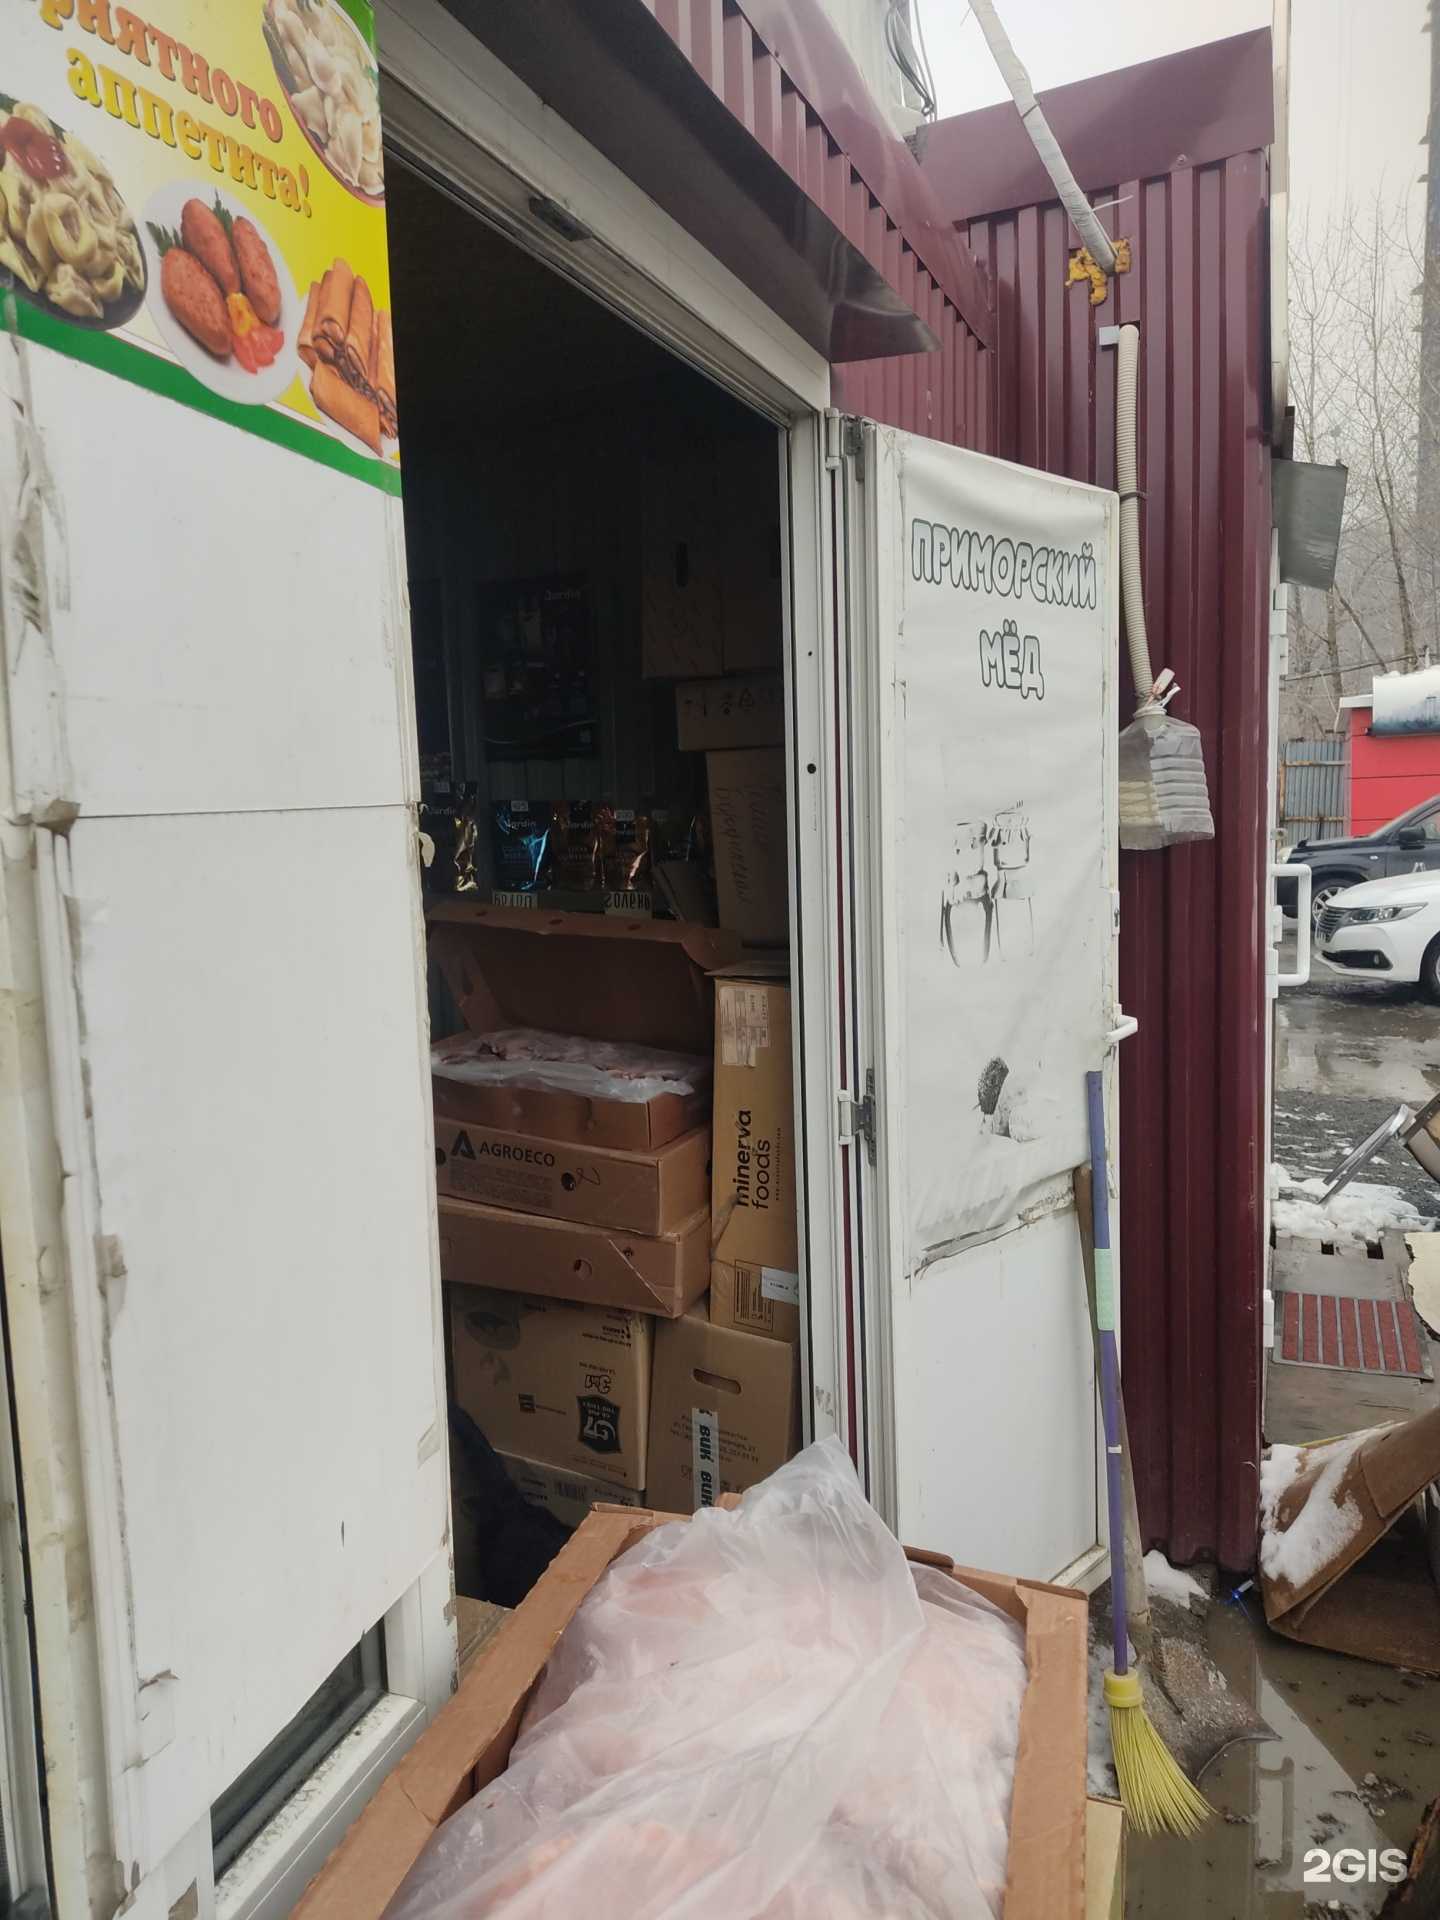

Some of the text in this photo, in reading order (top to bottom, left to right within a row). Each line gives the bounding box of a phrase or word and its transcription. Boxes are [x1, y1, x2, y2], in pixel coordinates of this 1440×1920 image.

[66, 47, 312, 219] аппетита!
[911, 517, 1097, 611] ПРИМОРСКИЙ
[979, 618, 1045, 701] МЁД
[480, 1141, 555, 1167] AGROECO
[732, 1109, 752, 1208] minerva
[752, 1138, 771, 1210] foods
